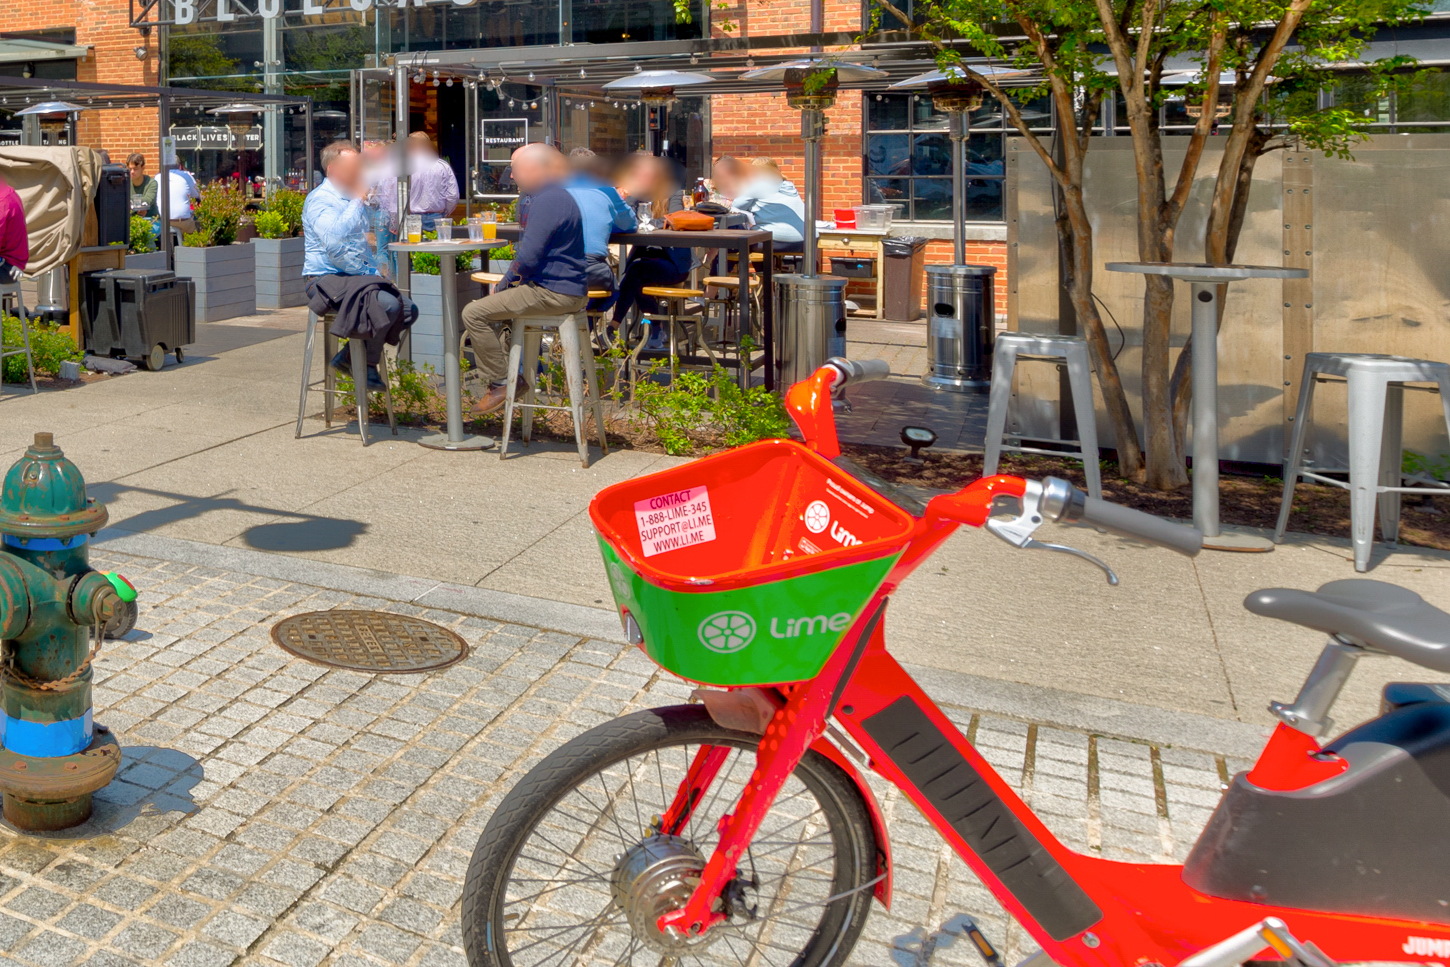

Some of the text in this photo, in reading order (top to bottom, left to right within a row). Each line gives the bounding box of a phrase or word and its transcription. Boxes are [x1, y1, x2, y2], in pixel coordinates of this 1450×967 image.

[201, 134, 229, 142] LIVES
[649, 490, 691, 510] CONTACT
[640, 501, 707, 527] 1-888-LIME-345
[640, 514, 712, 542] SUPPORT@LI.ME
[652, 530, 705, 553] WWW.LI.ME
[770, 612, 852, 639] Lime
